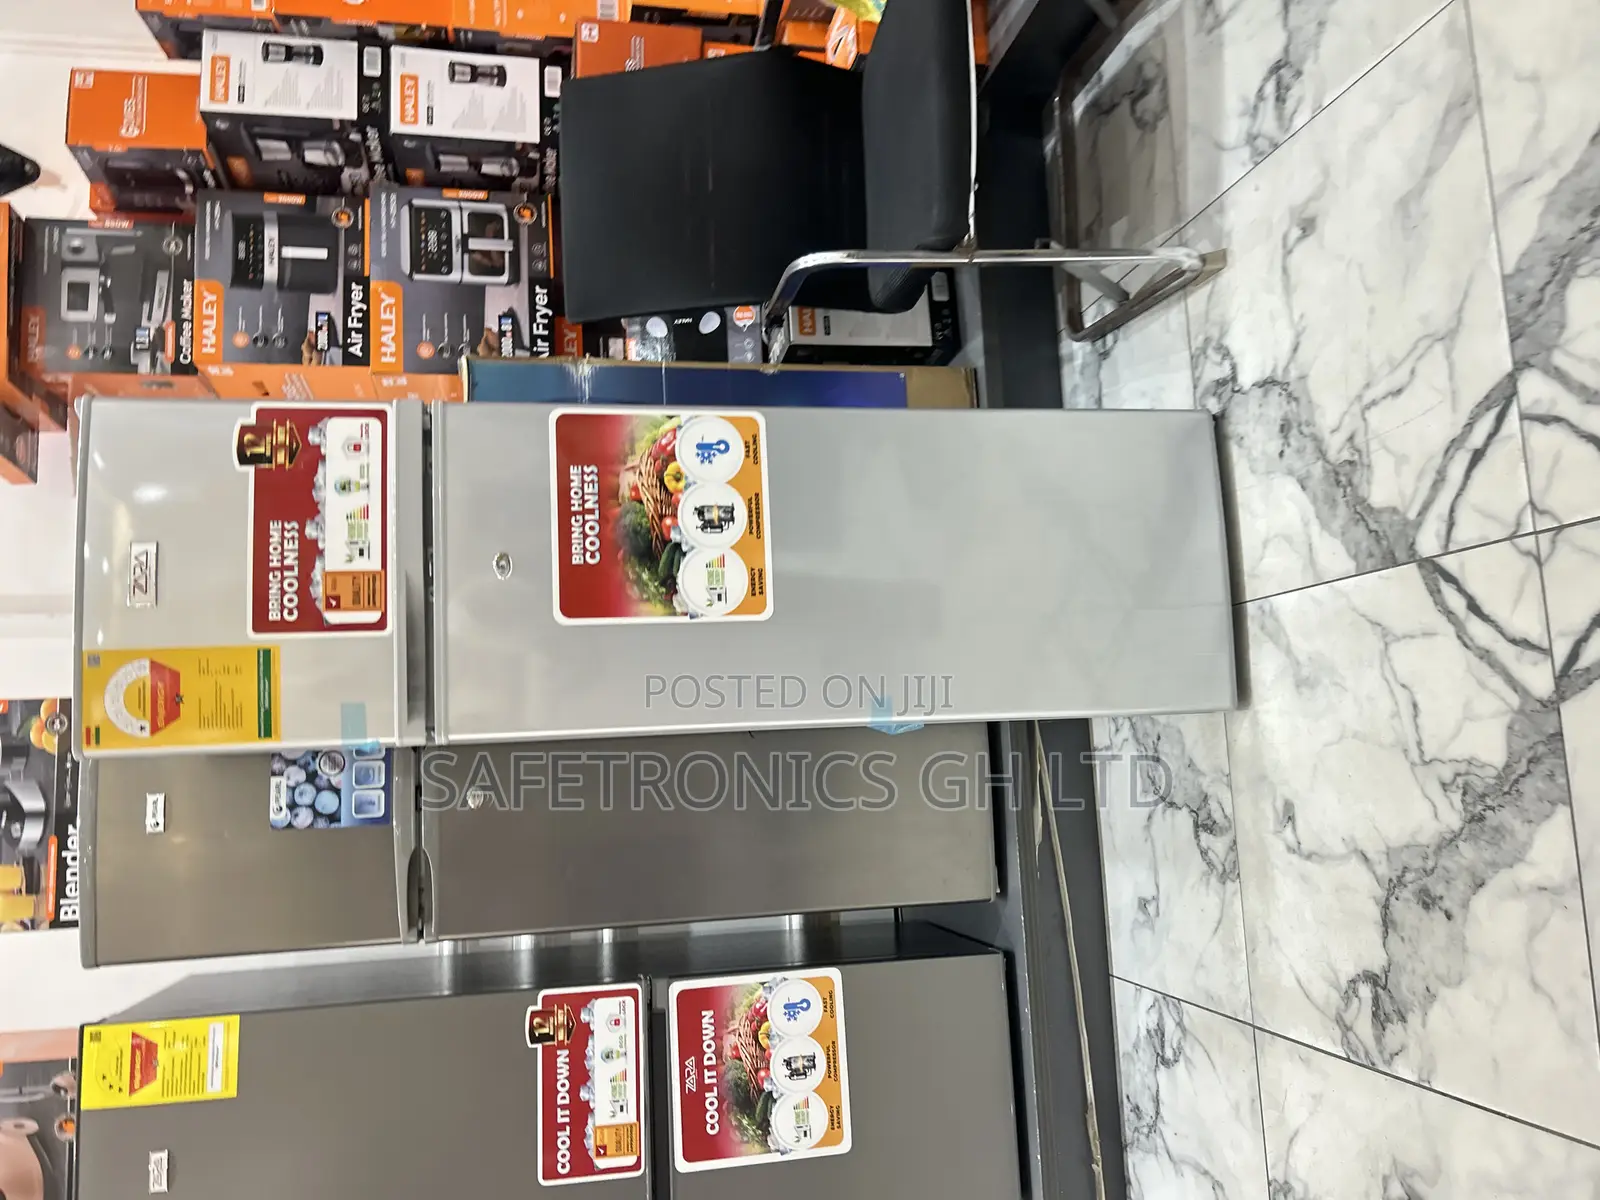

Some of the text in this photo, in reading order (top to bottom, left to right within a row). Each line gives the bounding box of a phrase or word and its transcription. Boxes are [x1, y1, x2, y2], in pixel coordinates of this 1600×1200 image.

[403, 76, 415, 123] HALEY
[180, 279, 193, 365] Coffee Maker
[203, 290, 217, 354] HALEY
[348, 282, 367, 357] Air Fryer
[381, 293, 396, 363] HALEY
[533, 284, 554, 335] Fryer
[751, 434, 759, 465] COOLING
[570, 465, 584, 565] BRING HOME
[584, 464, 602, 565] COOLNESS
[754, 492, 762, 540] COMPRESSOR
[268, 520, 282, 621] BRING HOME
[283, 520, 299, 622] COOLNESS
[59, 825, 79, 922] Blender
[533, 1016, 549, 1037] 12
[831, 1040, 839, 1082] COMPRESSOR
[701, 1010, 720, 1135] COOL IT DOWN
[556, 1049, 572, 1174] COOL IT DOWN
